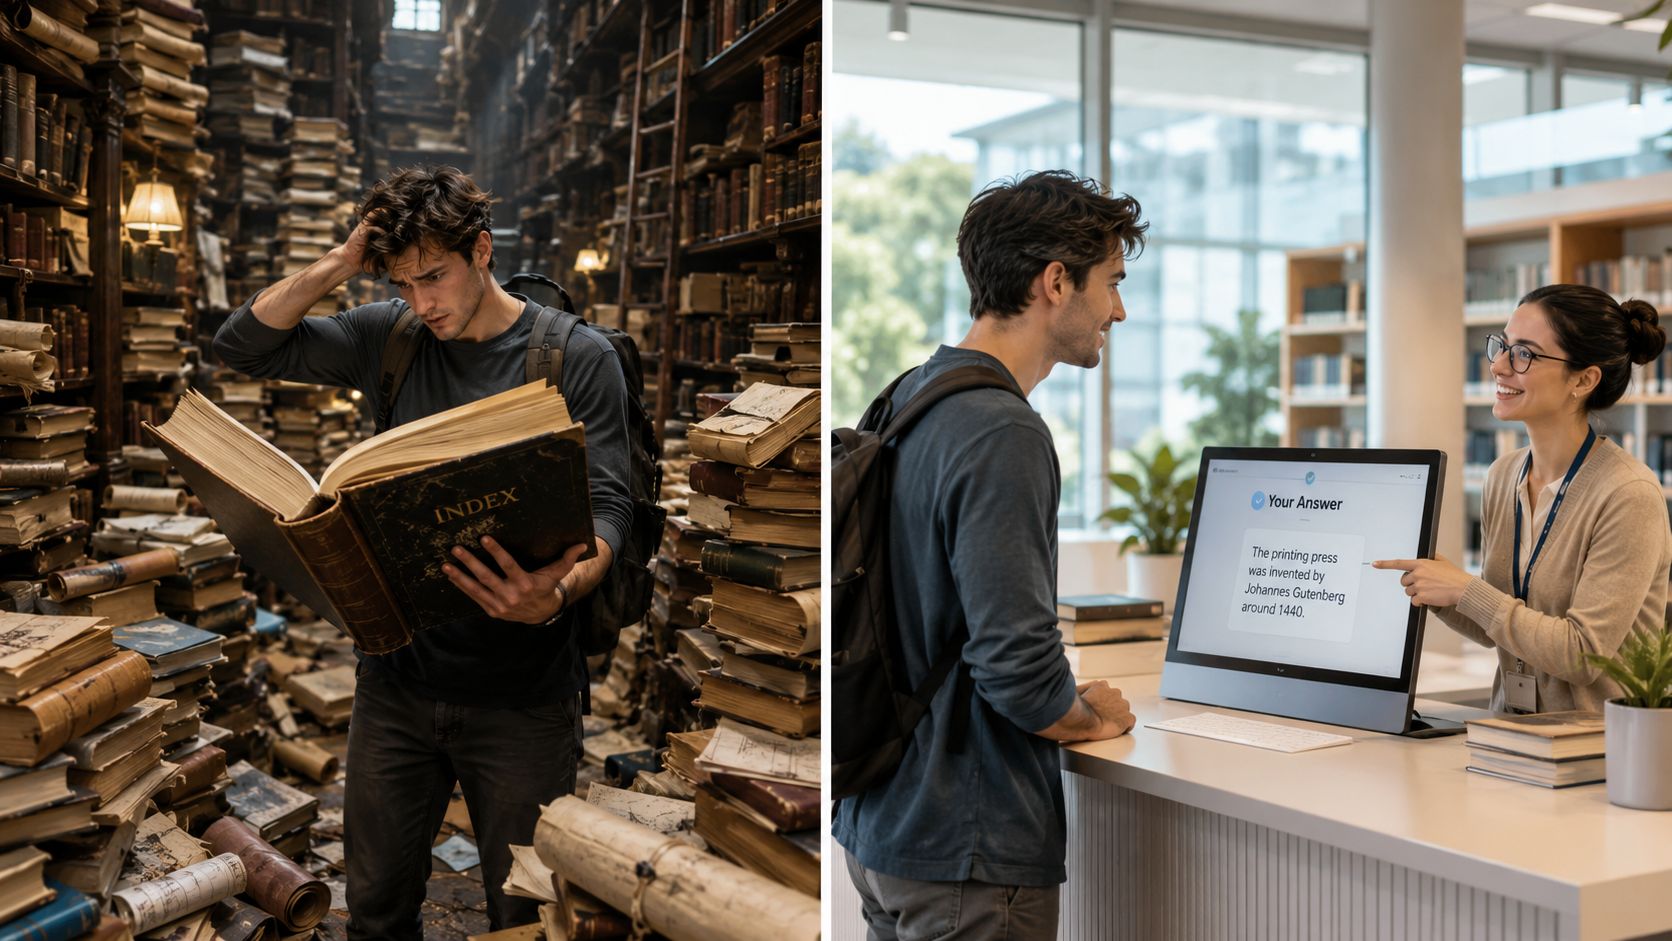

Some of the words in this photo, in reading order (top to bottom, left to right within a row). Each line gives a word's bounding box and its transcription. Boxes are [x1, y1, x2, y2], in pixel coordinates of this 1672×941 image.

[434, 487, 520, 525] INDEX
[1269, 494, 1295, 508] Your
[1296, 495, 1343, 510] Answer
[1252, 546, 1269, 558] The
[1271, 548, 1309, 564] printing
[1310, 553, 1338, 564] press
[1248, 567, 1267, 577] was
[1269, 565, 1311, 580] invented
[1312, 569, 1325, 584] by
[1244, 582, 1290, 597] Johannes
[1292, 586, 1345, 605] Gutenberg
[1241, 603, 1276, 615] around
[1279, 604, 1305, 618] 1440.
